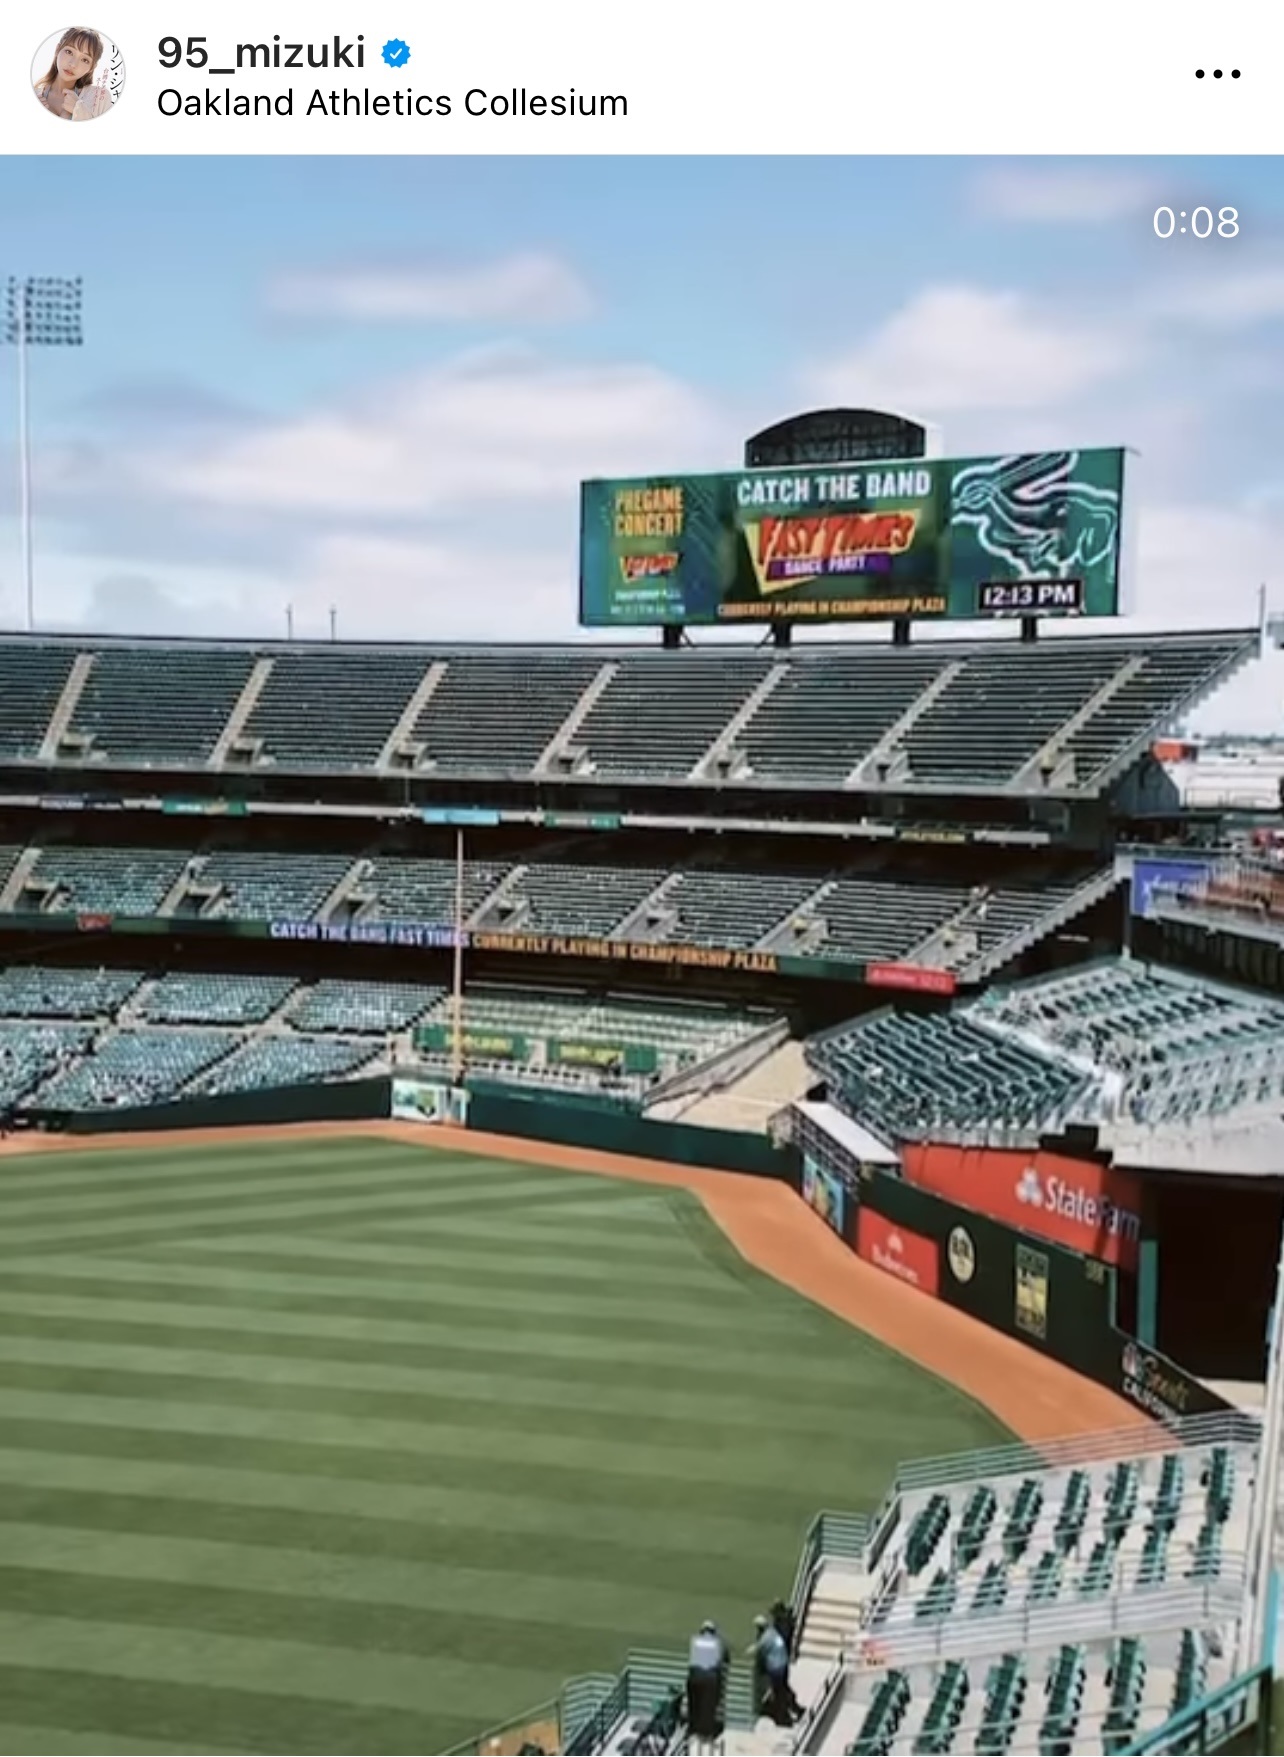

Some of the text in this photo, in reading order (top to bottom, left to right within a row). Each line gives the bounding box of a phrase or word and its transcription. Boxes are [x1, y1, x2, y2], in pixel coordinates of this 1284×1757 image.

[737, 470, 931, 505] CATCH THE BAND
[983, 583, 1075, 606] 12:13 PM
[270, 922, 318, 939] CATCH
